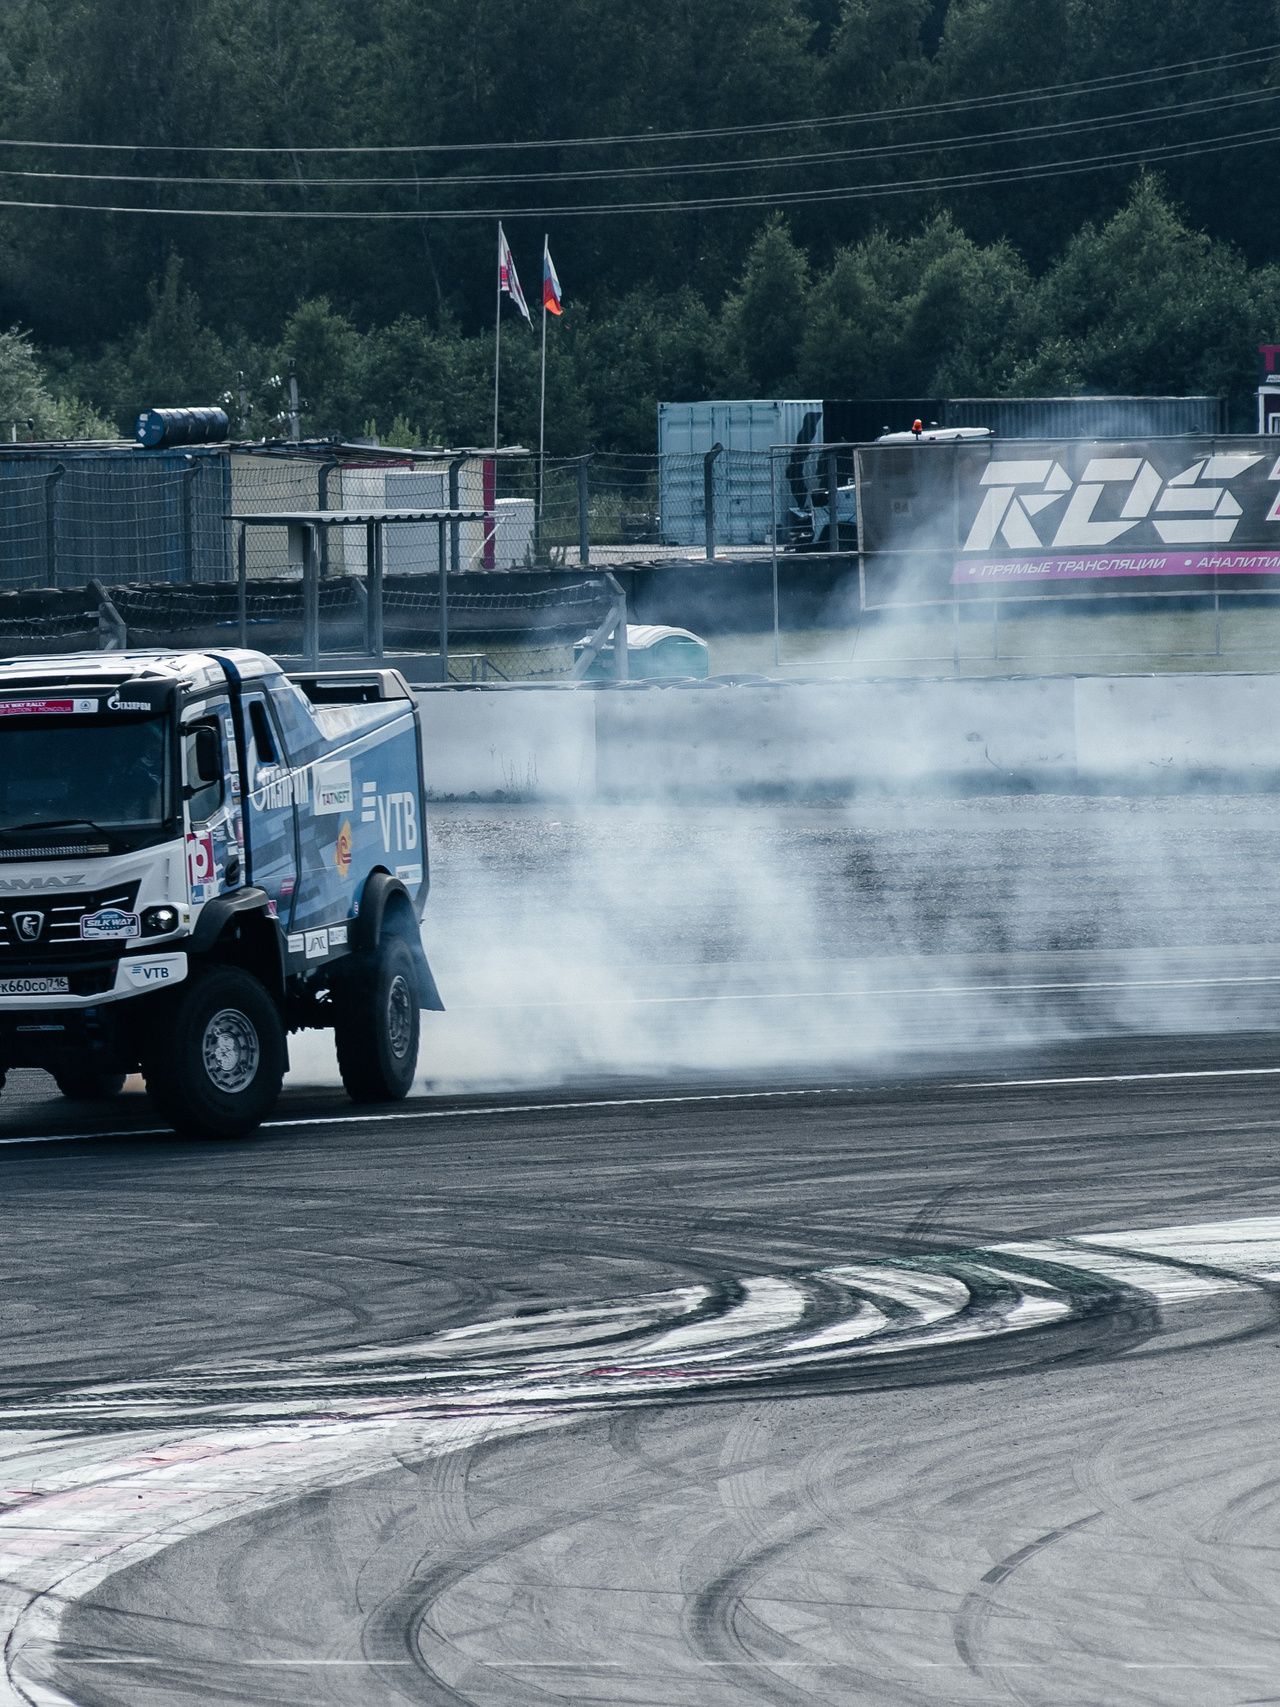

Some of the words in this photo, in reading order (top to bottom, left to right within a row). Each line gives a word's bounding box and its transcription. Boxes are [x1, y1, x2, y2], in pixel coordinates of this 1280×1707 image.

[963, 454, 1266, 551] RDS
[980, 562, 1051, 576] ПРЯМЫЕ
[1056, 557, 1167, 573] ТРАНСЛЯЦИИ
[321, 790, 350, 806] TATNEFT
[377, 791, 418, 853] VTB
[86, 919, 110, 927] SILK
[111, 918, 134, 926] WAY
[143, 967, 169, 979] VTB
